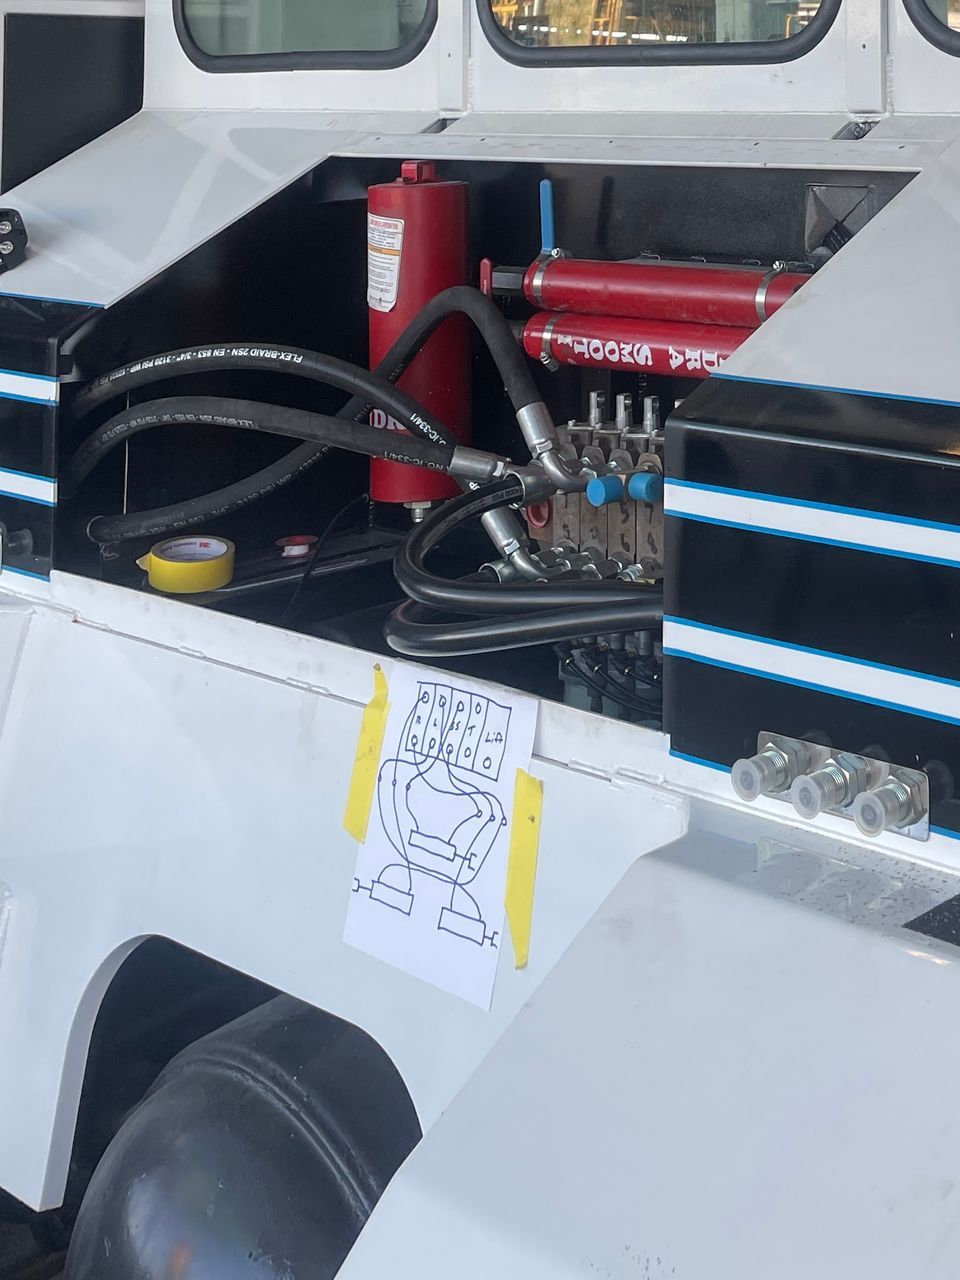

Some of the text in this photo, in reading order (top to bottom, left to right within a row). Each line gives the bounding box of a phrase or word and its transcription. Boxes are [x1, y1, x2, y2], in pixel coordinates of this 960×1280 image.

[197, 349, 212, 359] 853
[212, 348, 226, 357] EN
[230, 347, 249, 356] 2SN
[249, 348, 303, 363] FLEX-BRAID
[668, 345, 725, 373] DRA
